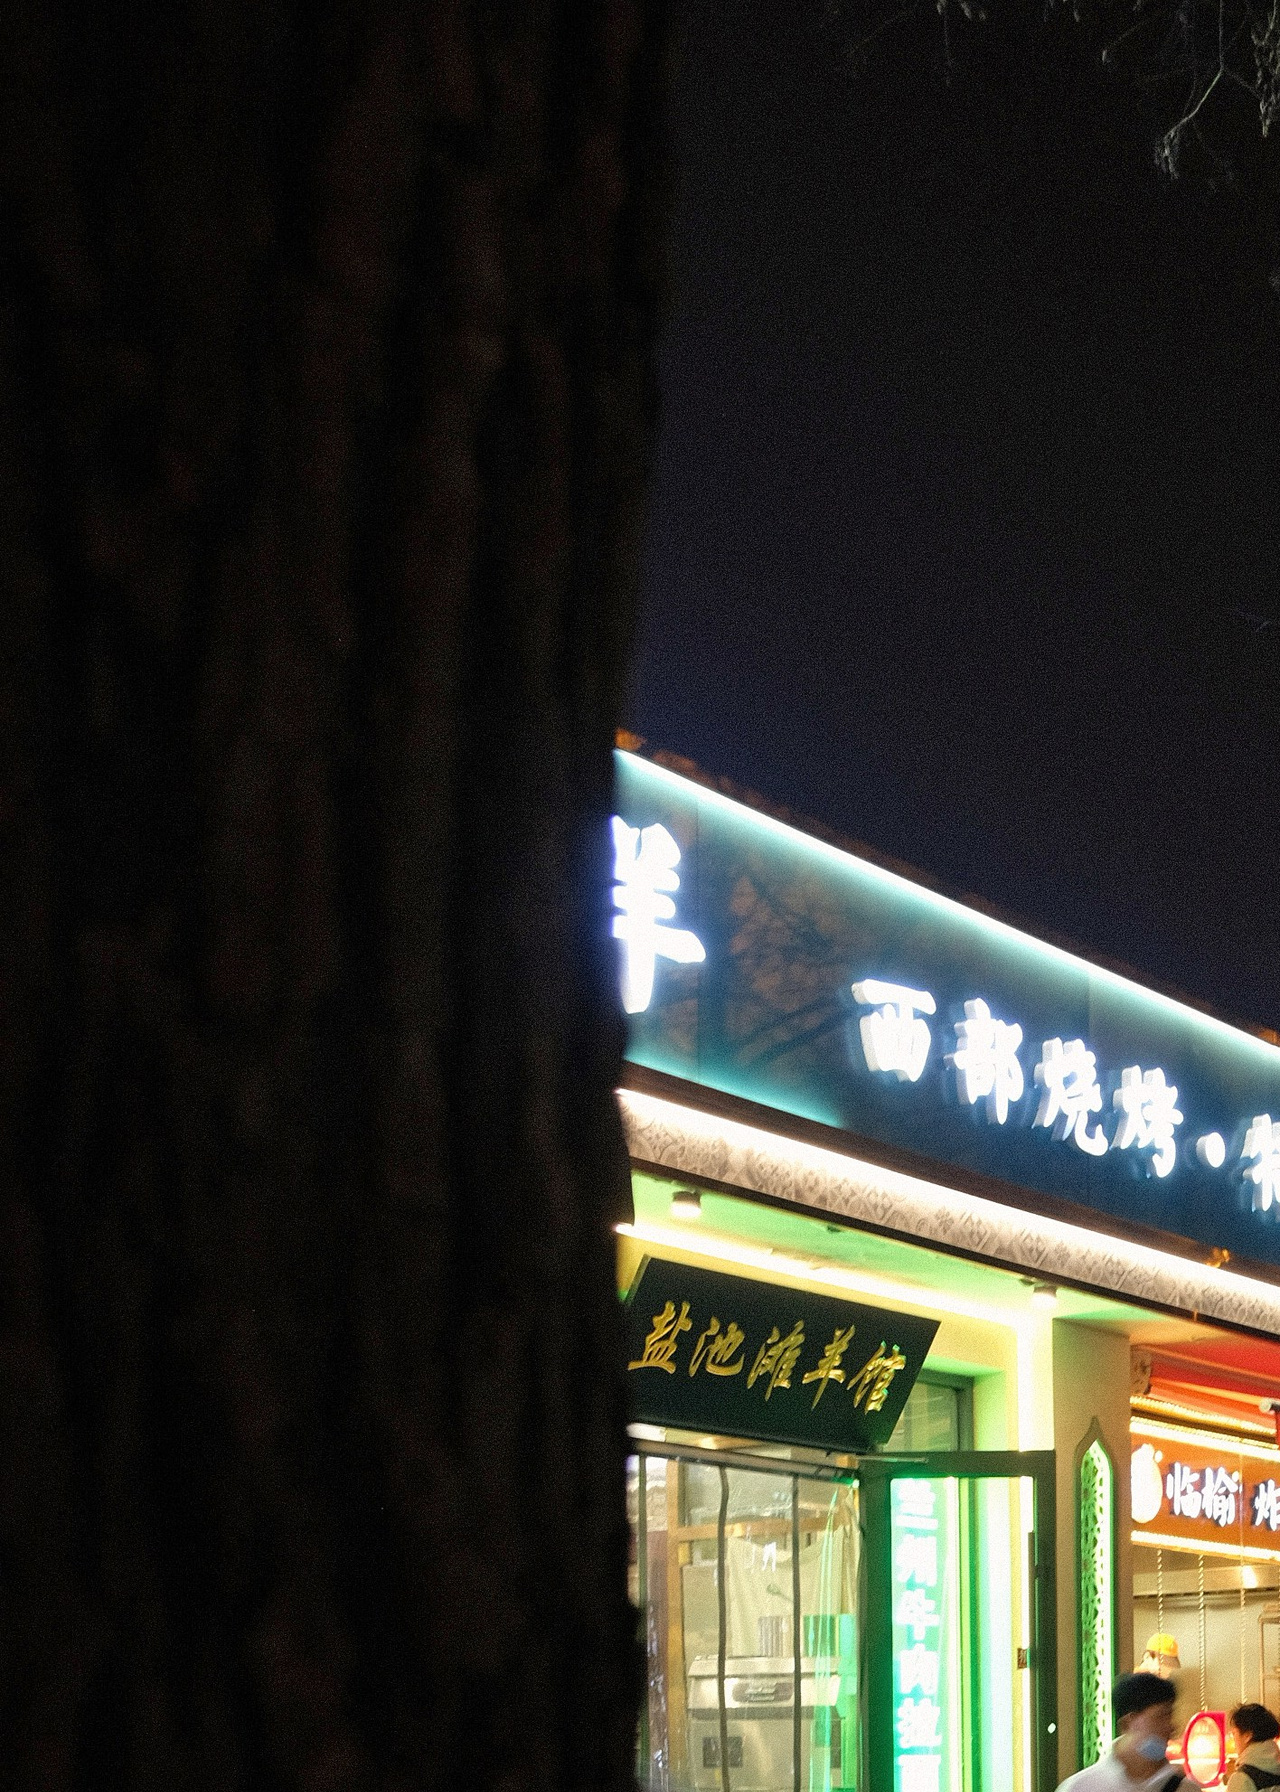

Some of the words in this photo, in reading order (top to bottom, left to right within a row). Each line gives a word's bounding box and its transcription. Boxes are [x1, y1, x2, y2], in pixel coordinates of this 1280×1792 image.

[627, 1301, 906, 1416] 盐池滩羊馆
[1167, 1462, 1240, 1527] 临榆
